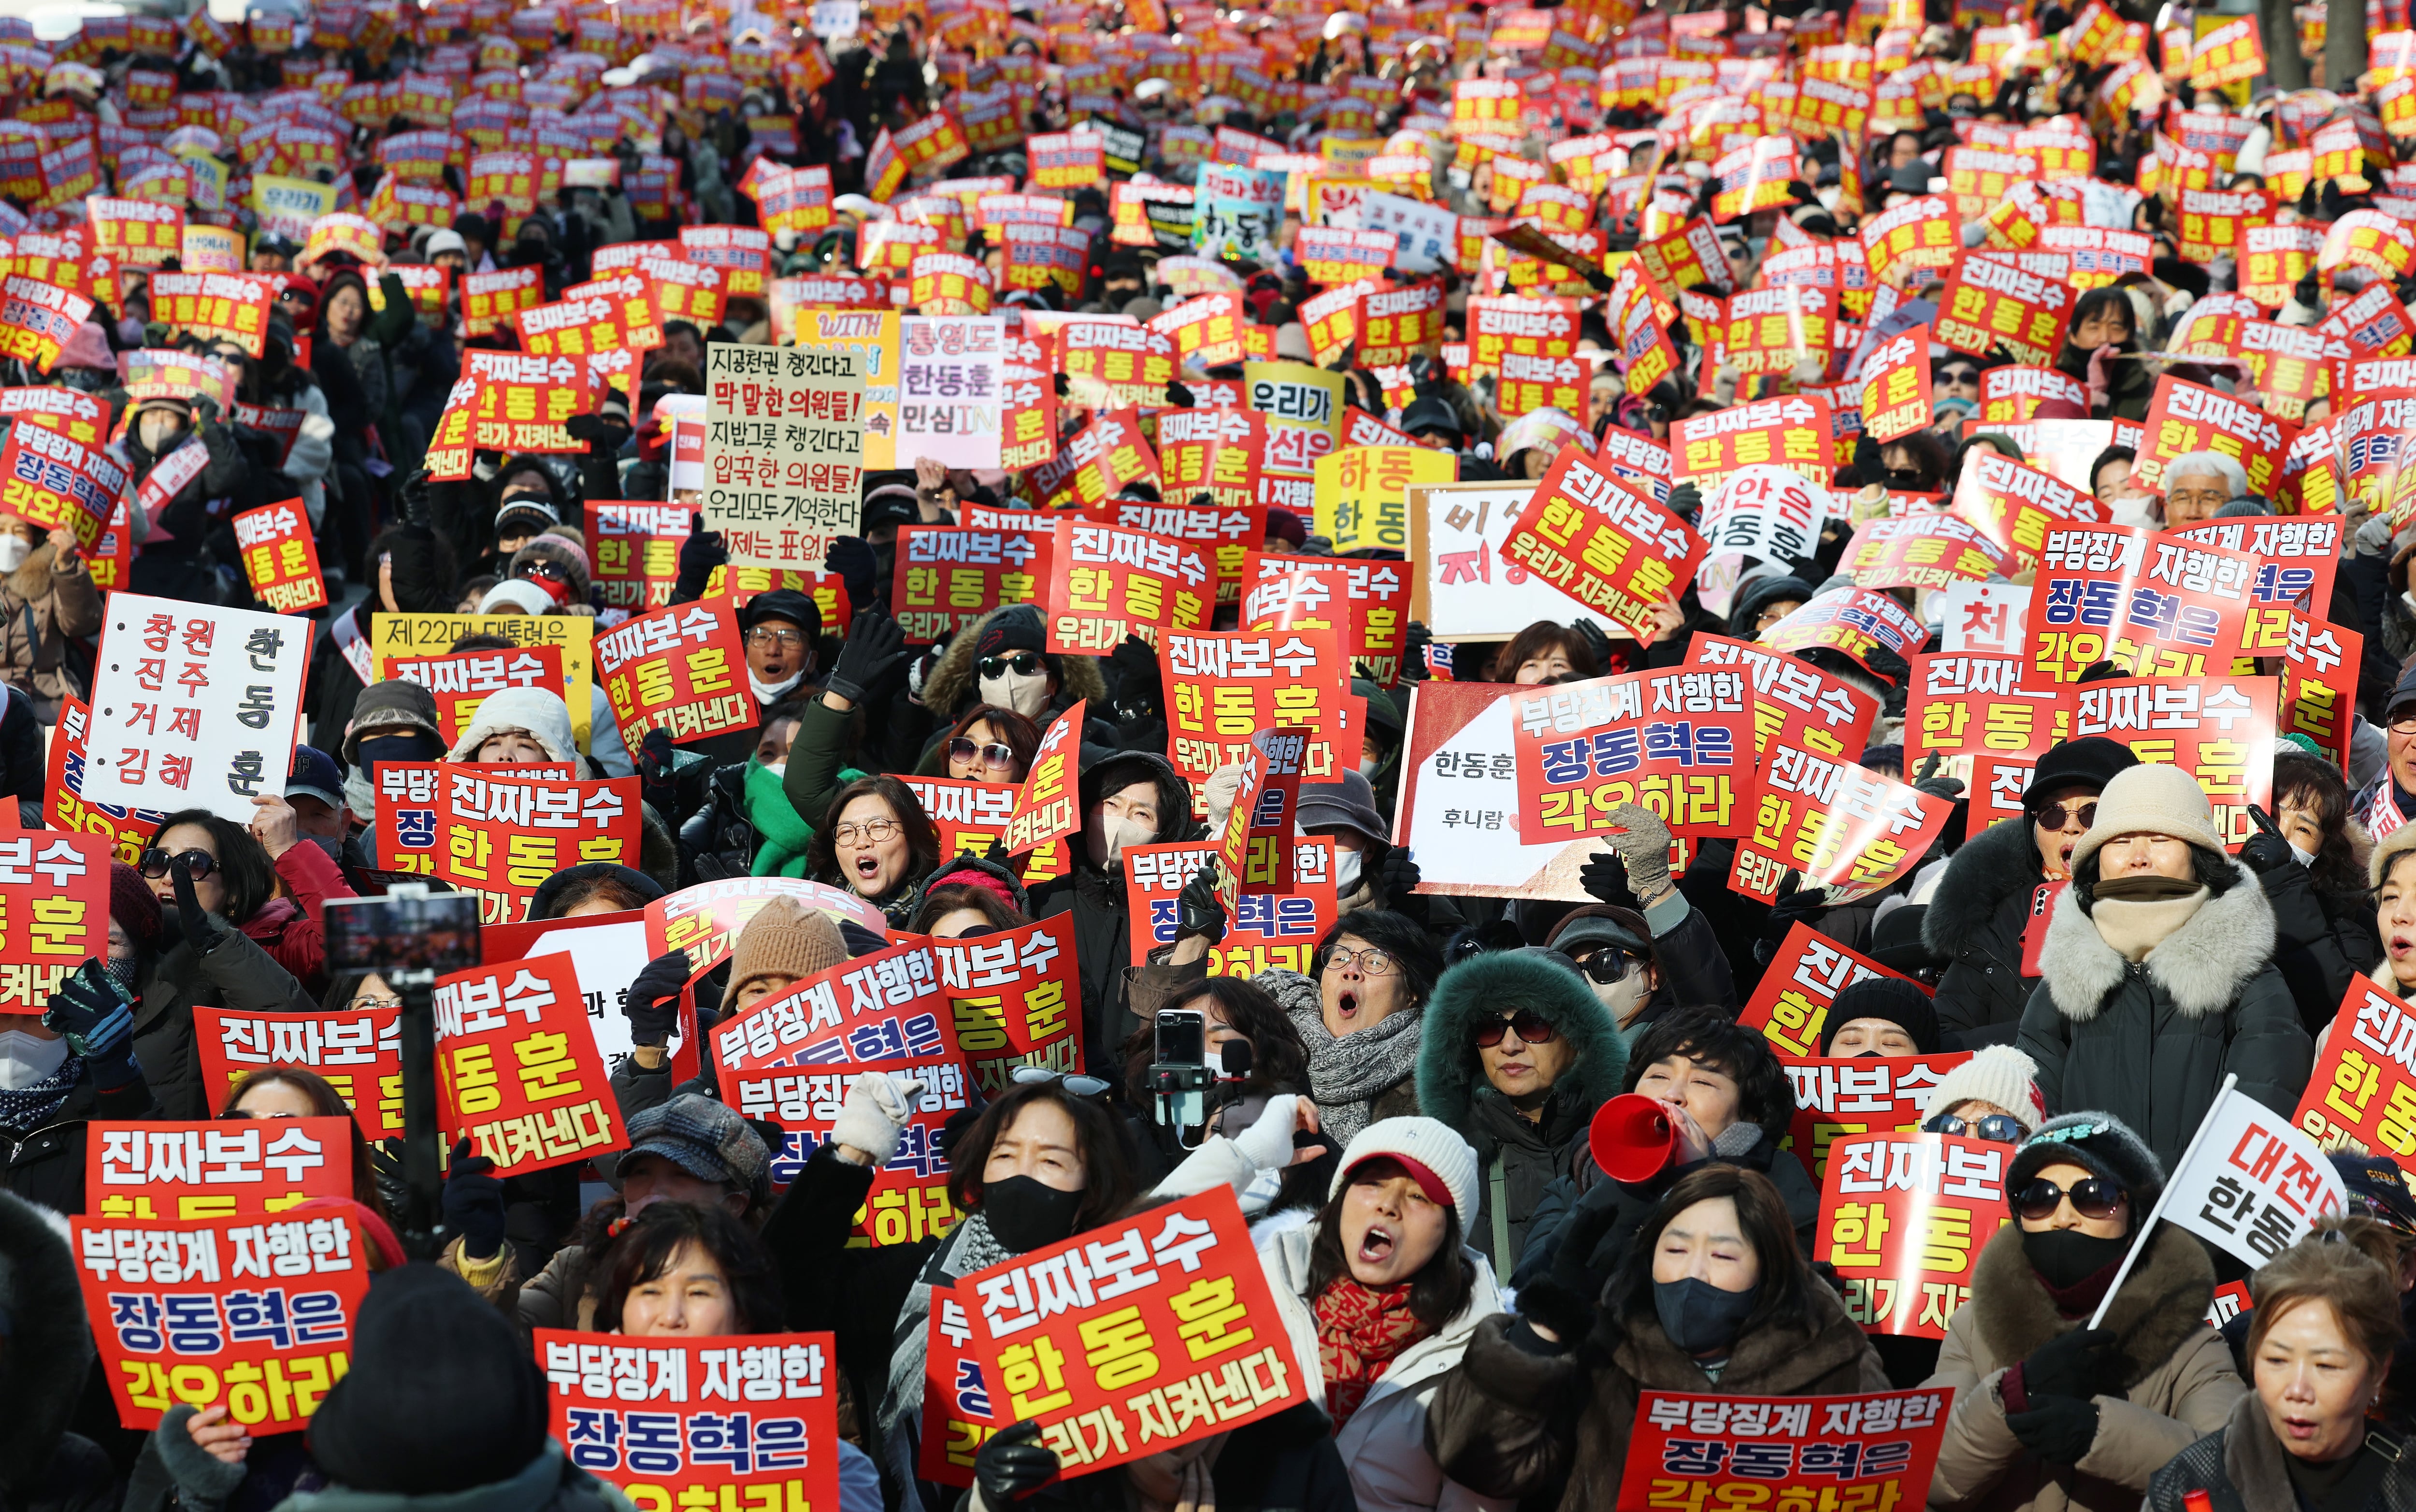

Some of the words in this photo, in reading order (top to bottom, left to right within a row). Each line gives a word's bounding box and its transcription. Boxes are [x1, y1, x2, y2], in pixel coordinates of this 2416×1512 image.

[1861, 196, 1949, 247] 진짜보수
[1366, 284, 1442, 317] 진짜보수
[1960, 255, 2066, 311] 진짜보수
[520, 297, 612, 334] 진짜보수
[819, 313, 881, 336] WITH
[1478, 309, 1571, 337] 진짜보수
[1936, 317, 1990, 353] 우리가
[907, 323, 997, 356] 통영도
[1065, 323, 1172, 355] 진짜보수
[2240, 319, 2352, 359] 진짜보수
[470, 352, 577, 384] 진짜보수
[787, 352, 856, 378] 챙긴다고
[905, 363, 996, 398] 한동훈
[1502, 353, 1581, 383] 진짜보수
[788, 389, 861, 423] 의원들!
[1254, 382, 1332, 424] 우리가
[1683, 397, 1816, 441] 진짜보수
[2166, 382, 2283, 452] 진짜보수
[14, 421, 86, 465] 부당징계
[786, 425, 860, 454] 챙긴다고
[1160, 409, 1251, 443] 진짜보수
[16, 450, 110, 519] 장동혁은
[786, 462, 861, 493] 의원들!
[1118, 504, 1251, 540] 진짜보수
[1558, 459, 1691, 561] 진짜보수
[908, 531, 1036, 566] 진짜보수
[1070, 525, 1207, 587] 진짜보수
[1868, 513, 2004, 562] 진짜보수
[2252, 521, 2338, 558] 자행한
[1510, 531, 1577, 589] 우리가
[1571, 567, 1655, 640] 지켜낸다
[2043, 530, 2145, 577] 부당징계
[2149, 543, 2251, 600] 자행한
[264, 576, 321, 612] 지켜낸다
[2045, 577, 2221, 648] 장동혁은
[1055, 616, 1129, 652] 우리가
[1861, 591, 1926, 645] 자행한
[596, 606, 720, 675] 진짜보수
[1168, 636, 1317, 679] 진짜보수
[396, 653, 545, 694] 진짜보수
[656, 693, 749, 740] 지켜낸다
[1520, 680, 1643, 738] 부당징계
[1651, 671, 1744, 715] 자행한
[2077, 684, 2253, 736] 진짜보수
[1176, 740, 1222, 774] 우리가
[1541, 721, 1734, 785] 장동혁은
[450, 773, 623, 829] 진짜보수
[1767, 744, 1927, 835] 진짜보수
[1442, 808, 1504, 831] 후니랑
[718, 980, 842, 1071] 부당징계
[841, 946, 939, 1016] 자행한
[739, 1073, 853, 1122] 부당징
[101, 1127, 324, 1185] 진짜보수
[2367, 1169, 2398, 1183] CUBA
[81, 1228, 221, 1284] 부당징계
[229, 1217, 352, 1279] 자행한
[977, 1211, 1218, 1339] 진짜보수
[108, 1288, 347, 1355] 장동혁은
[546, 1342, 688, 1402] 부당징계
[700, 1344, 826, 1400] 자행한
[1127, 1346, 1290, 1445] 지켜낸다
[1648, 1398, 1811, 1438] 부당징계
[1821, 1396, 1941, 1438] 자행한
[566, 1407, 808, 1475] 장동혁은
[1663, 1439, 1912, 1480] 장동혁은
